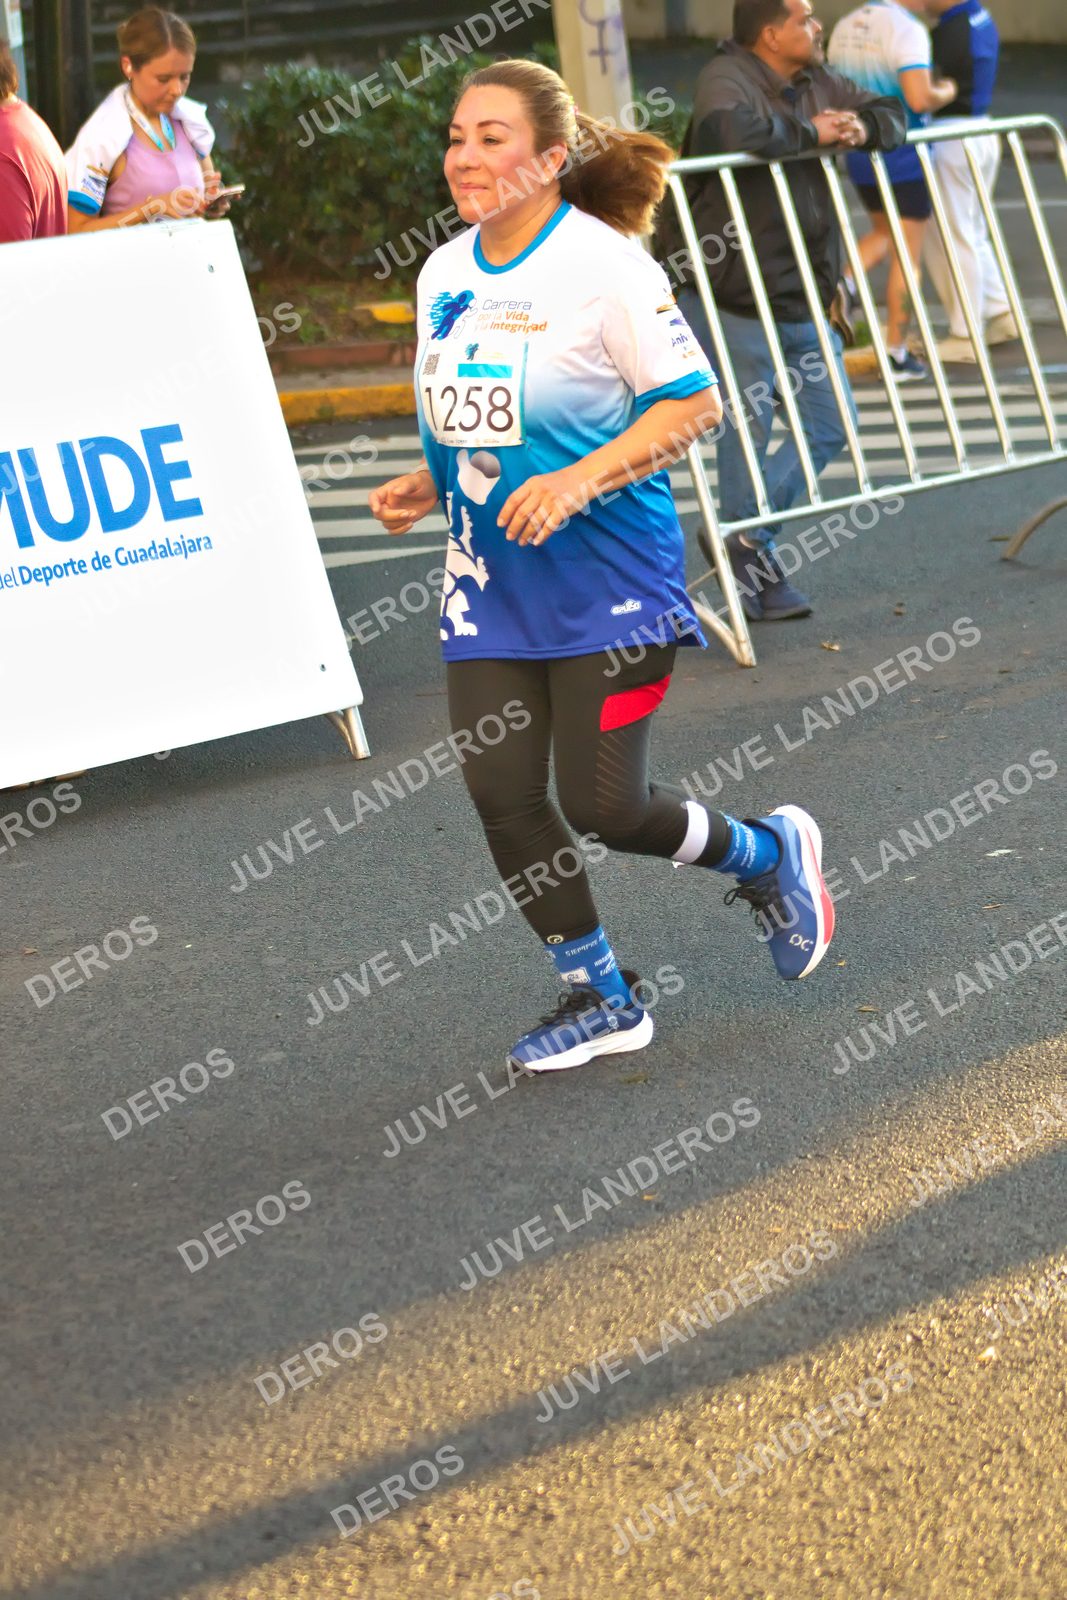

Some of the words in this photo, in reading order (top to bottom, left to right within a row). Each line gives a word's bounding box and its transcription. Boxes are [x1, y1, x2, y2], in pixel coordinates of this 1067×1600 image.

[482, 299, 532, 311] Carrera
[505, 310, 530, 322] Vida
[424, 385, 514, 433] 1258
[18, 558, 89, 586] Deporte
[91, 550, 112, 572] de
[114, 534, 213, 567] Guadalajara
